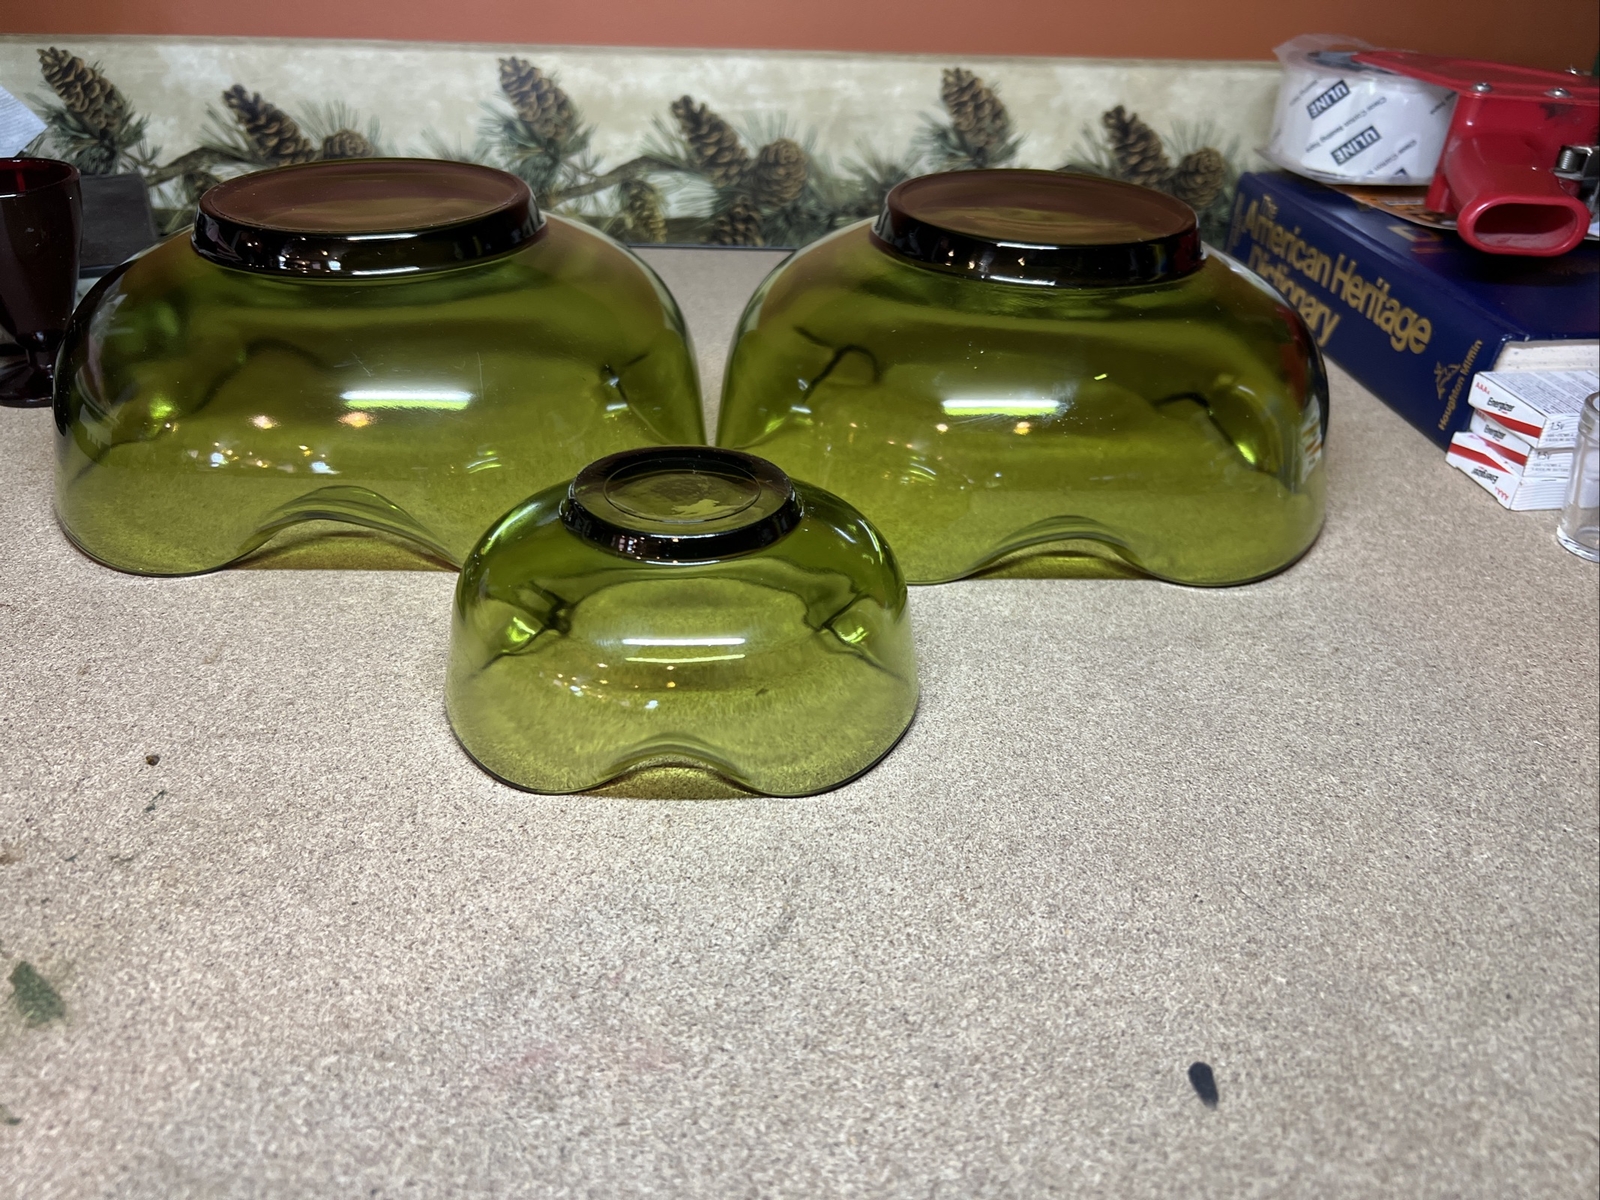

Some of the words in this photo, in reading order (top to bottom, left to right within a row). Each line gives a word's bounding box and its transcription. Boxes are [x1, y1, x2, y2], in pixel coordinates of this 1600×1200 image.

[1308, 82, 1349, 118] ULINE
[1333, 128, 1380, 165] ULINE
[1245, 200, 1332, 289] American
[1330, 253, 1432, 354] Heritage
[1248, 243, 1341, 347] Dictionary
[1438, 374, 1466, 431] Houghton
[1460, 339, 1483, 376] Mifflin
[1487, 397, 1515, 413] Energizer
[1471, 467, 1499, 485] Energizer
